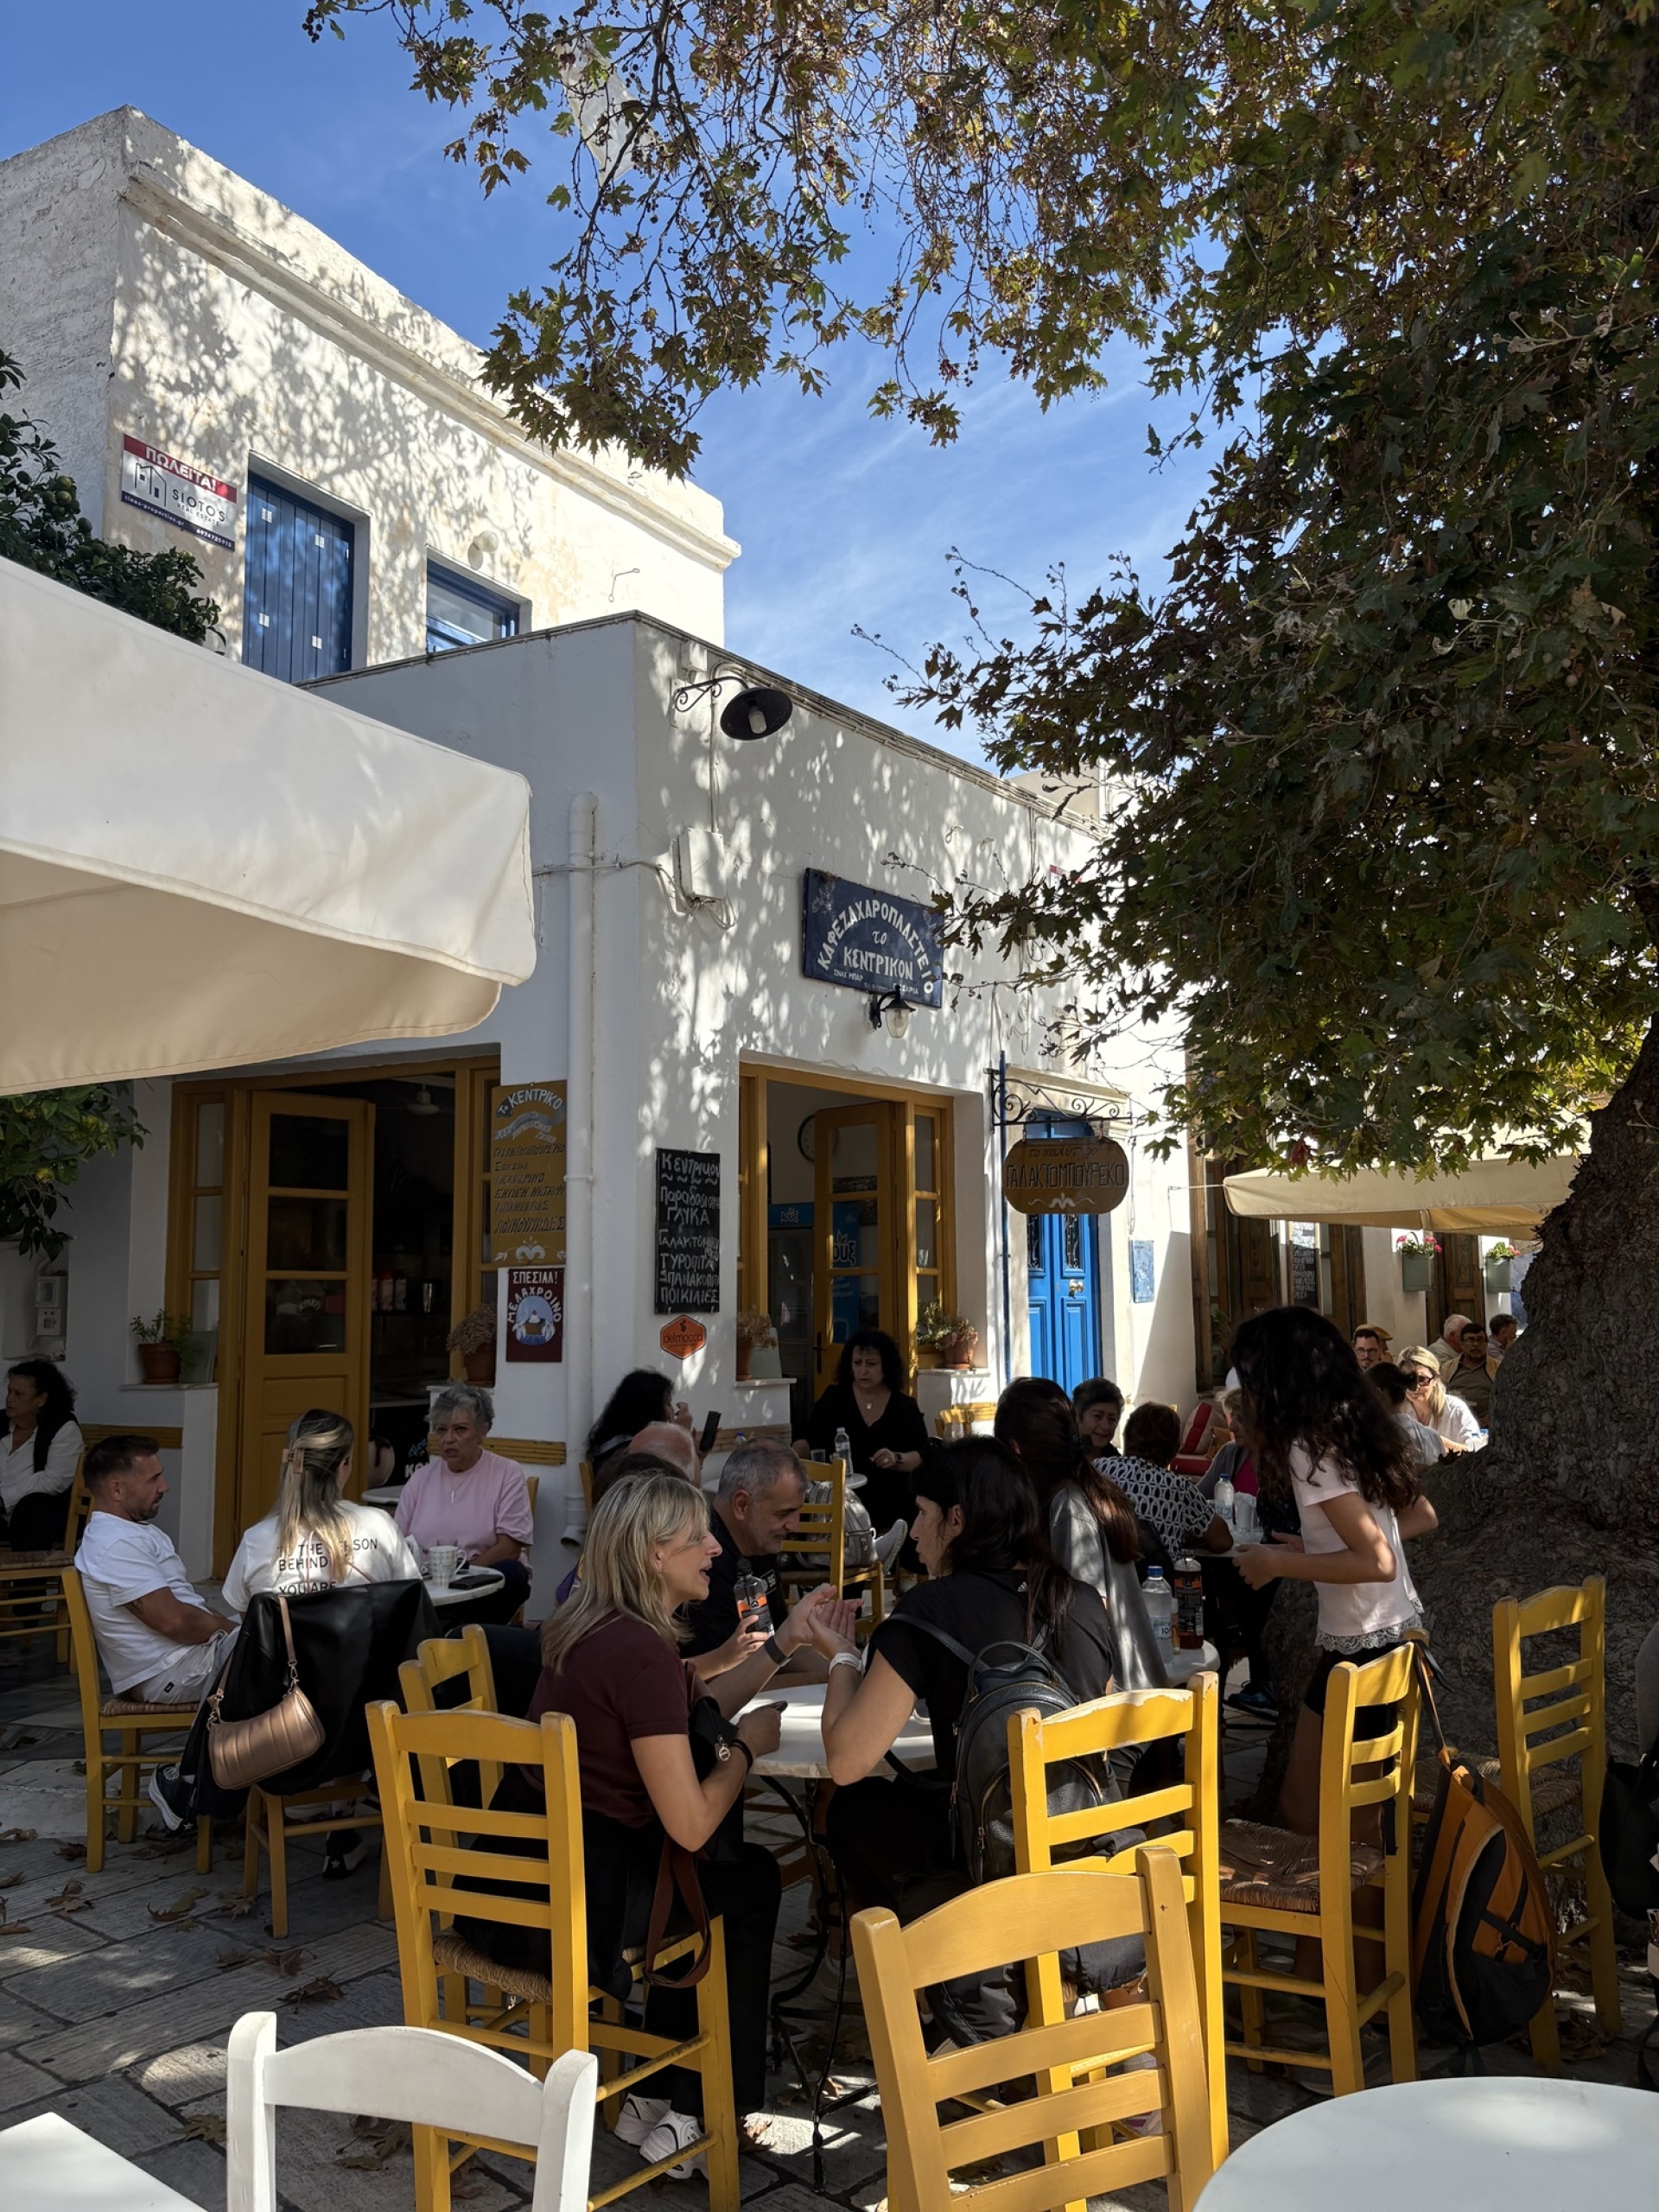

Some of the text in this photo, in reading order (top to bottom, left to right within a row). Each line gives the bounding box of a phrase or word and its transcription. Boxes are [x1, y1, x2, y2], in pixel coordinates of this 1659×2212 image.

[145, 447, 217, 492] ΠΩΛΕΙΤΑΙ
[172, 488, 226, 522] SIOTOS
[177, 503, 220, 526] REAL ESTATE
[817, 899, 933, 994] ΚΑΦΕΖΑΧΑΡΟΠΛΑΣΤΕΙΟ
[508, 1089, 563, 1110] ΚΕΝΤΡΙΚΟ
[1007, 1162, 1126, 1190] ΓΑΛΑΚΤΟΜΠΟΥΡΕΚΟ
[512, 1271, 558, 1284] ΣΠΕΣΙΑΛ!
[279, 1554, 328, 1572] BEHIND
[279, 1583, 306, 1596] YOU
